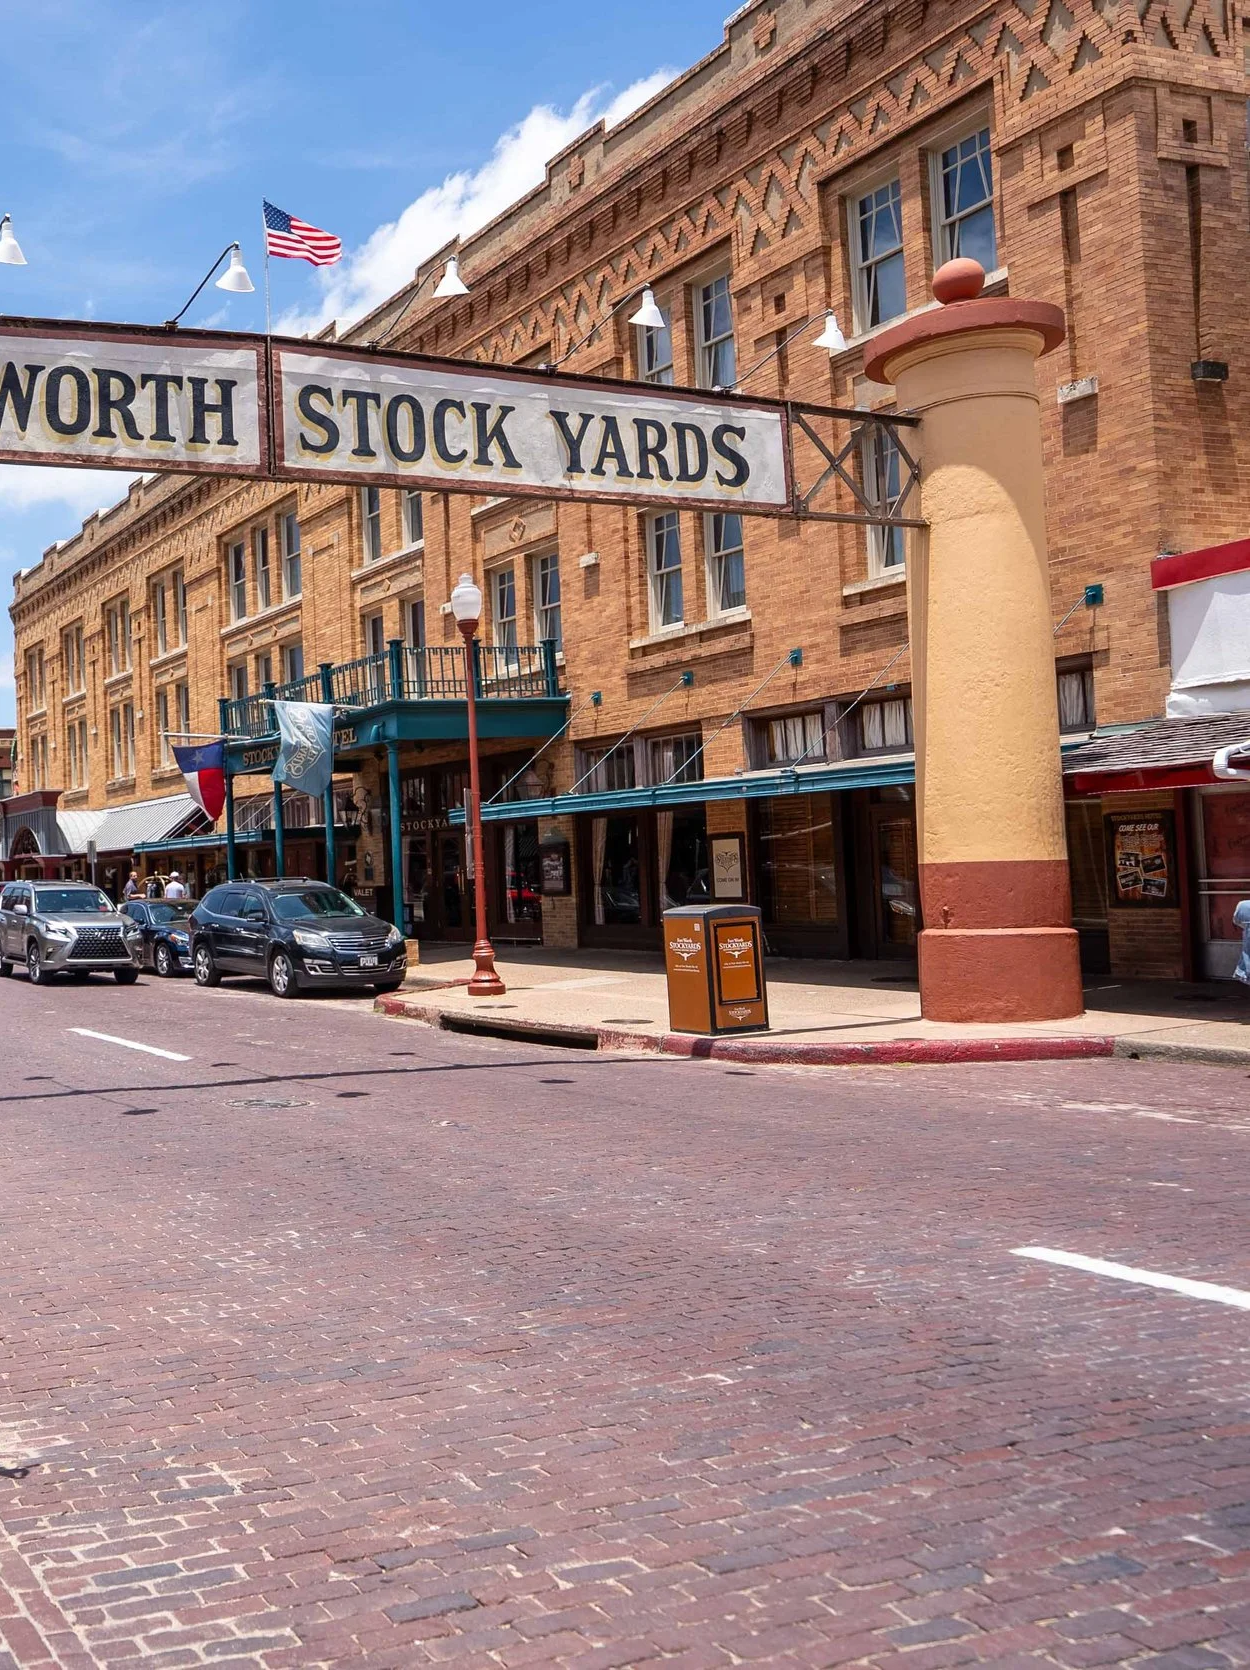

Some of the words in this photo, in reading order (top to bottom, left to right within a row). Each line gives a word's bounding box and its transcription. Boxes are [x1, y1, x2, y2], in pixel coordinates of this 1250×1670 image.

[296, 384, 523, 475] STOCK
[548, 409, 748, 493] YARDS
[242, 746, 282, 768] STOCKY
[333, 728, 358, 746] TEL
[400, 818, 449, 831] STOCKYA
[1118, 824, 1135, 832] COME
[1135, 823, 1147, 831] SEE
[353, 888, 374, 897] VALET
